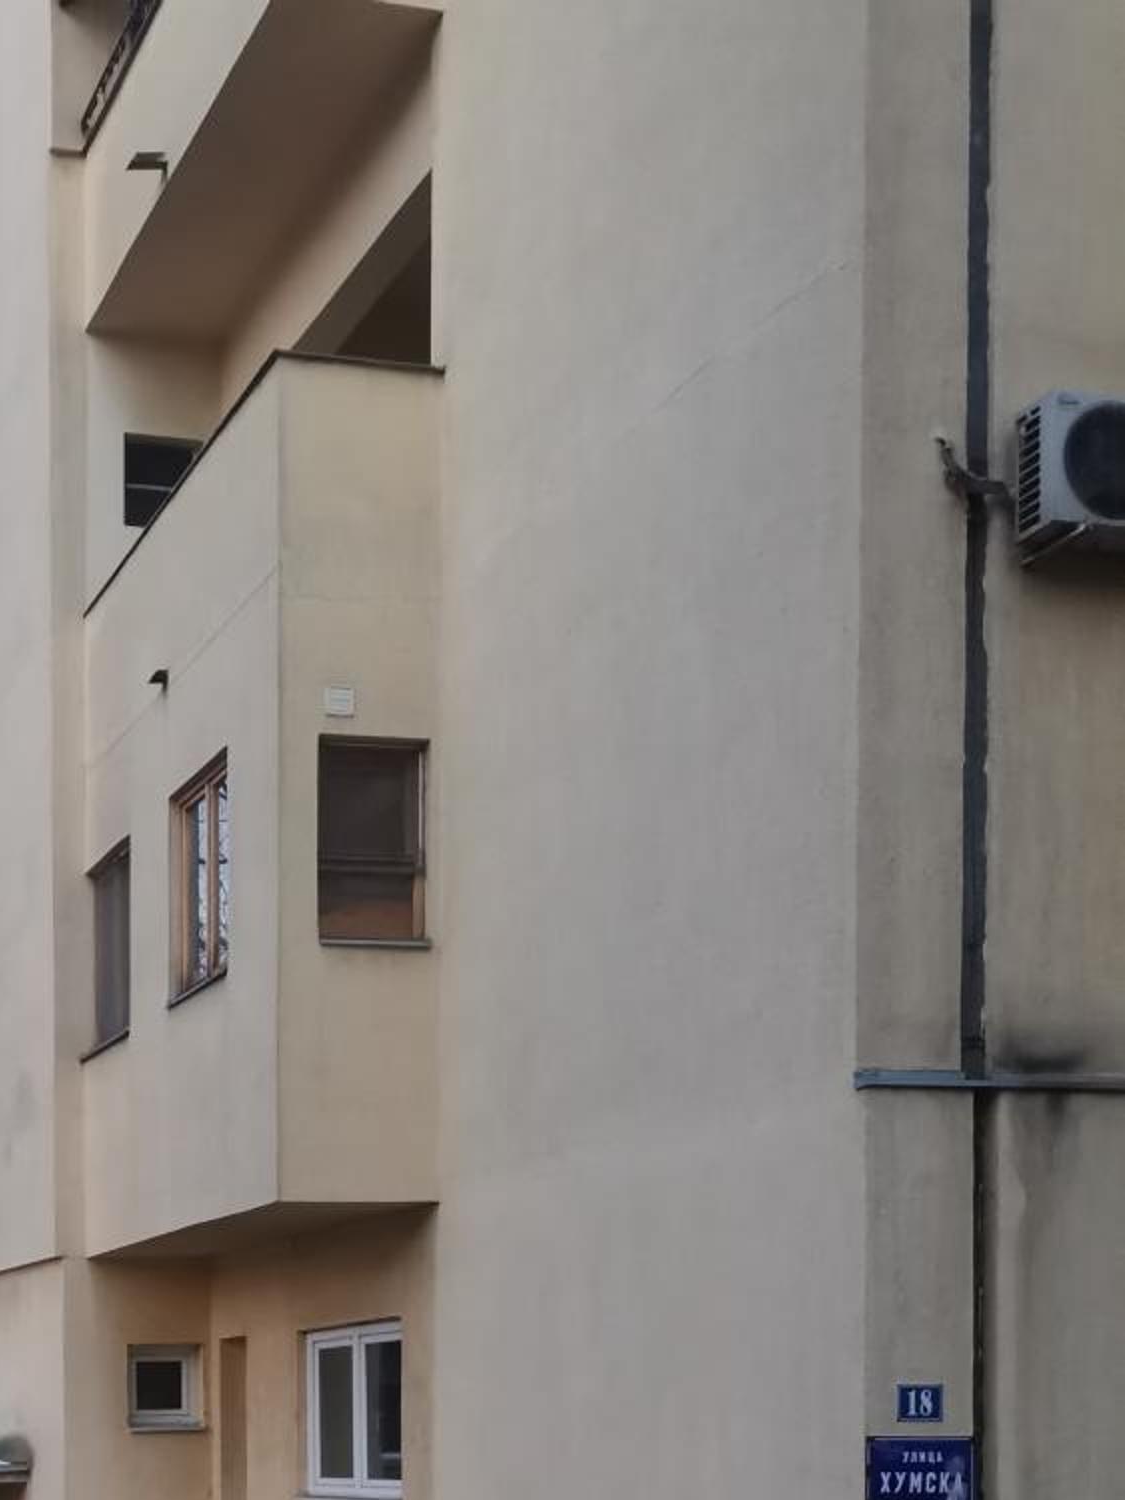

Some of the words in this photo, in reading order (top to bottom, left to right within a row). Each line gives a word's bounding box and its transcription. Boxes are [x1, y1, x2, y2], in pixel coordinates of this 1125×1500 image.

[907, 1389, 934, 1417] 18
[902, 1451, 944, 1464] УЛИЦА
[880, 1471, 964, 1494] ХУМСКА
